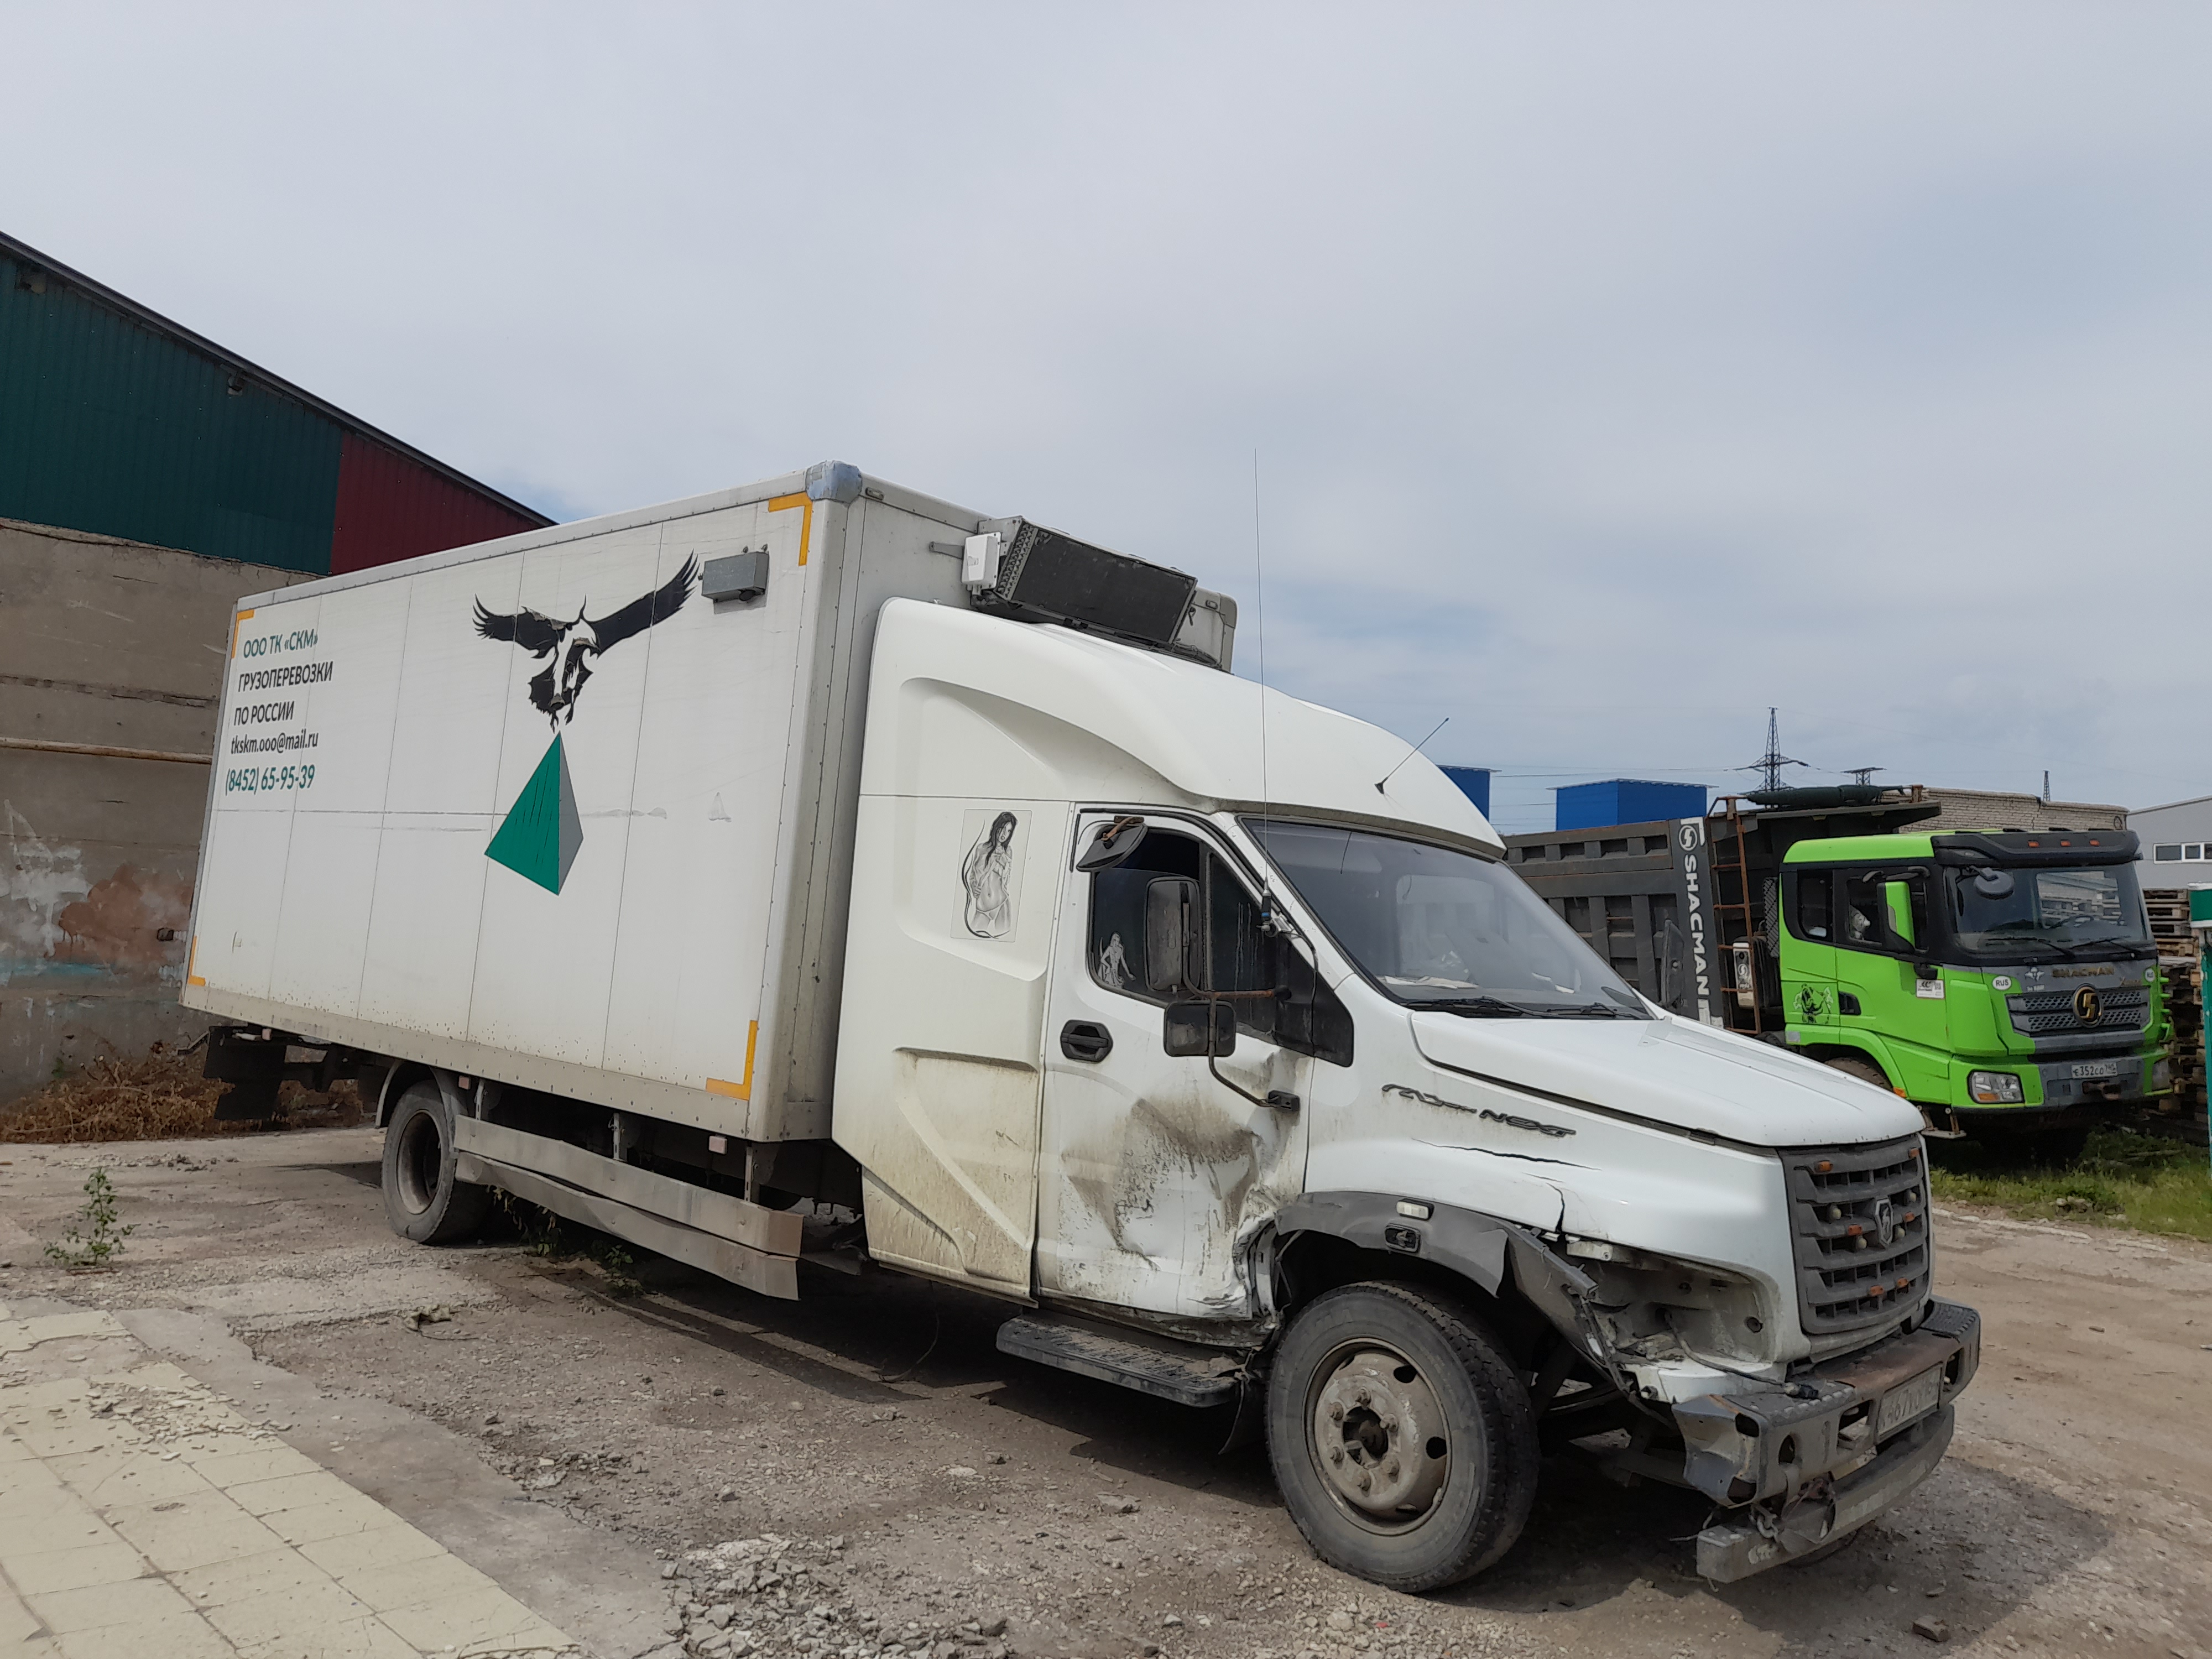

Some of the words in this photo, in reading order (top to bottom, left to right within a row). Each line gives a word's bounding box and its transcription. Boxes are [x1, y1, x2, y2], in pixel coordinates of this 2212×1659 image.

[243, 638, 267, 658] ООО
[269, 634, 283, 655] ТК
[284, 628, 319, 651] «СКМ»
[238, 661, 333, 692] ГРУЗОПЕРЕВОЗКИ
[233, 706, 249, 726] ПО
[251, 701, 295, 724] РОССИИ
[231, 729, 319, 755] tkskm.ooo@mail.ru
[225, 766, 259, 796] (8452)
[261, 764, 316, 791] 65-95-39
[1684, 854, 1710, 996] SHACMAN
[1995, 978, 2009, 987] RUS
